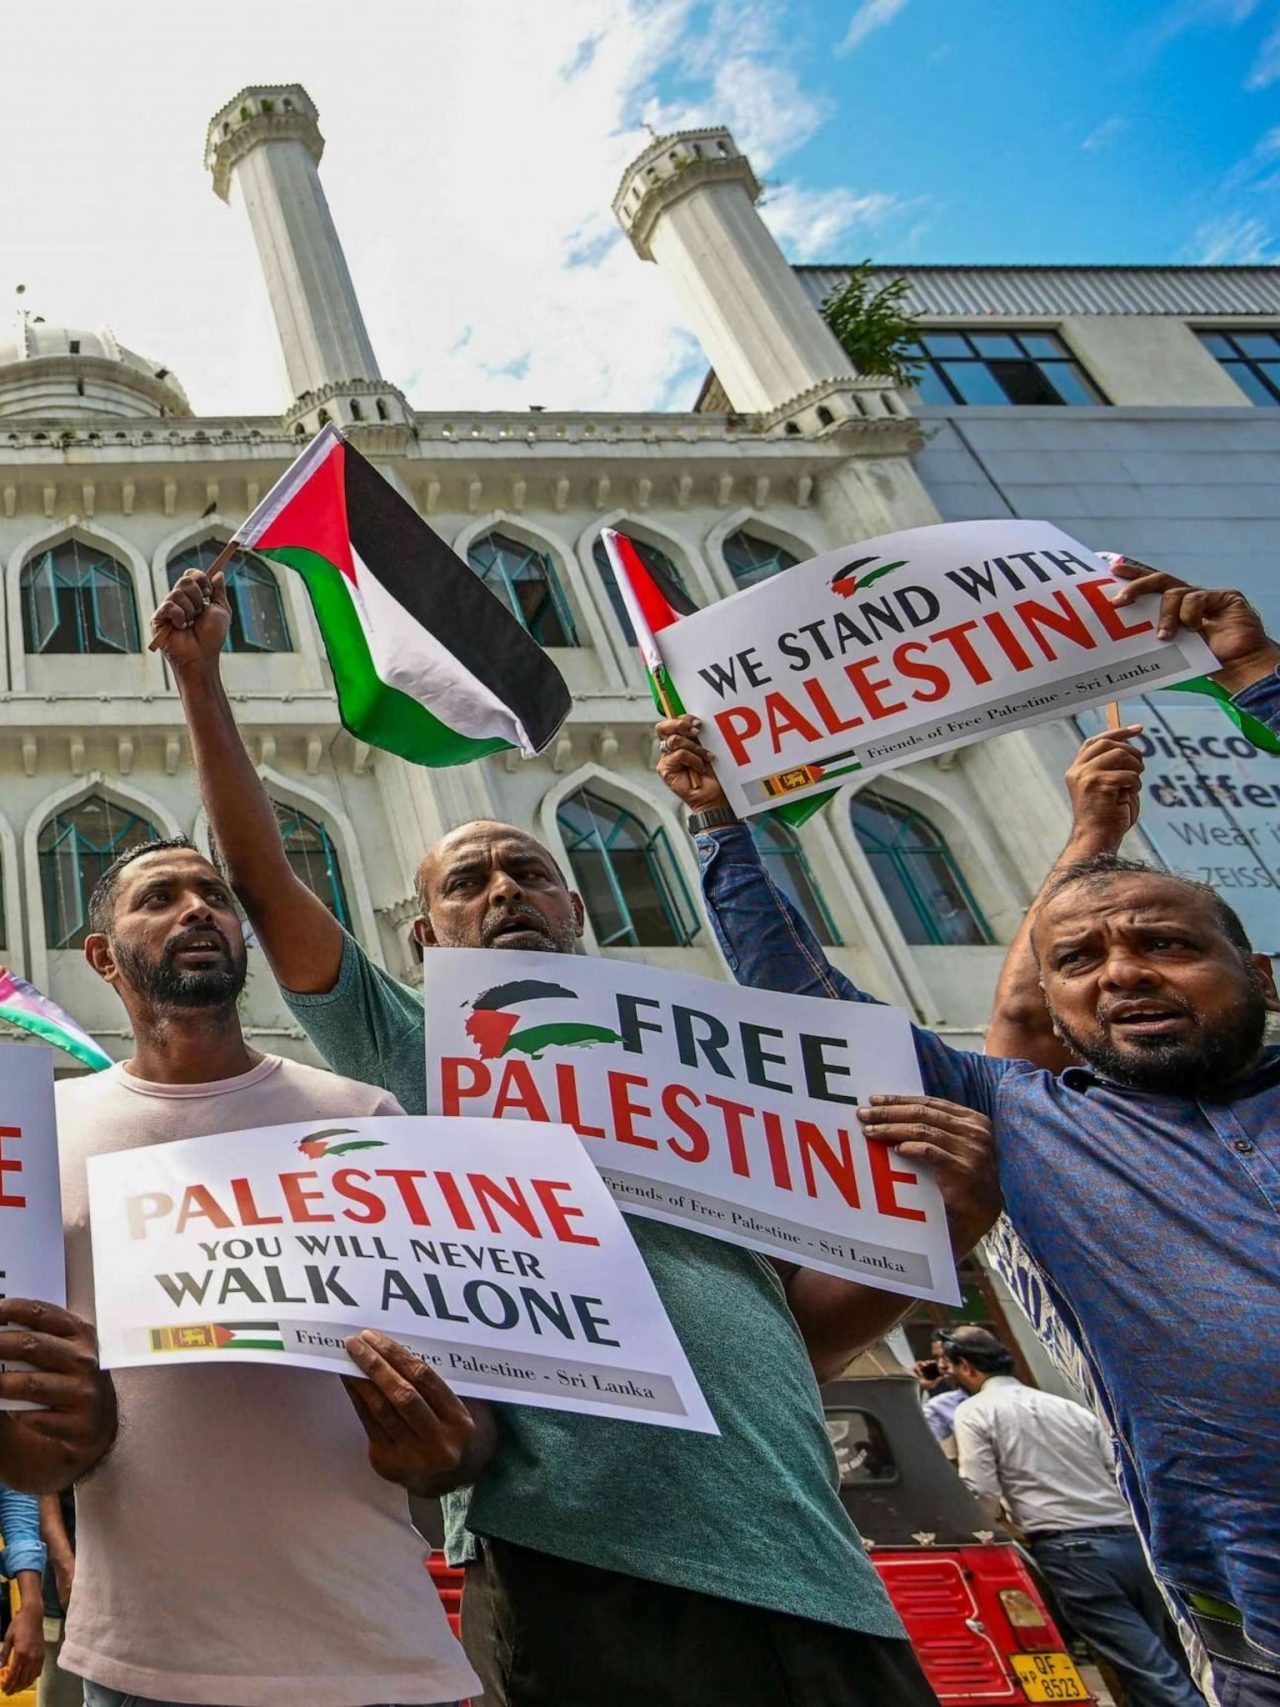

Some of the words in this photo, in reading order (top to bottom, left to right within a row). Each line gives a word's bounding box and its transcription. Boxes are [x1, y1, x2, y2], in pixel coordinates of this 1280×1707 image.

[695, 647, 772, 700] WE
[777, 585, 942, 672] STAND
[945, 548, 1097, 603] WITH
[713, 577, 1155, 768] PALESTINE
[867, 735, 924, 759] Friends
[927, 726, 943, 740] of
[946, 716, 982, 733] Free
[986, 694, 1059, 721] Palestine
[1075, 678, 1102, 694] Sri
[1105, 662, 1160, 684] Lanka
[1128, 727, 1259, 760] Disco
[1168, 821, 1260, 847] Wear
[615, 993, 859, 1106] FREE
[441, 1056, 927, 1223] PALESTINE
[126, 1168, 602, 1248] PALESTINE
[602, 1175, 663, 1201] Friends
[669, 1196, 685, 1208] of
[690, 1199, 725, 1220] Free
[731, 1211, 801, 1244] Palestine
[819, 1239, 845, 1258] Sri
[850, 1248, 906, 1274] Lanka
[198, 1236, 284, 1262] YOU
[295, 1235, 399, 1262] WILL
[409, 1239, 545, 1280] NEVER
[154, 1265, 360, 1309] WALK
[380, 1268, 622, 1349] ALONE
[295, 1329, 348, 1350] Frien
[448, 1352, 537, 1381] Palestine
[556, 1369, 586, 1388] Sri
[591, 1374, 655, 1400] Lanka
[1041, 1677, 1080, 1698] 8523
